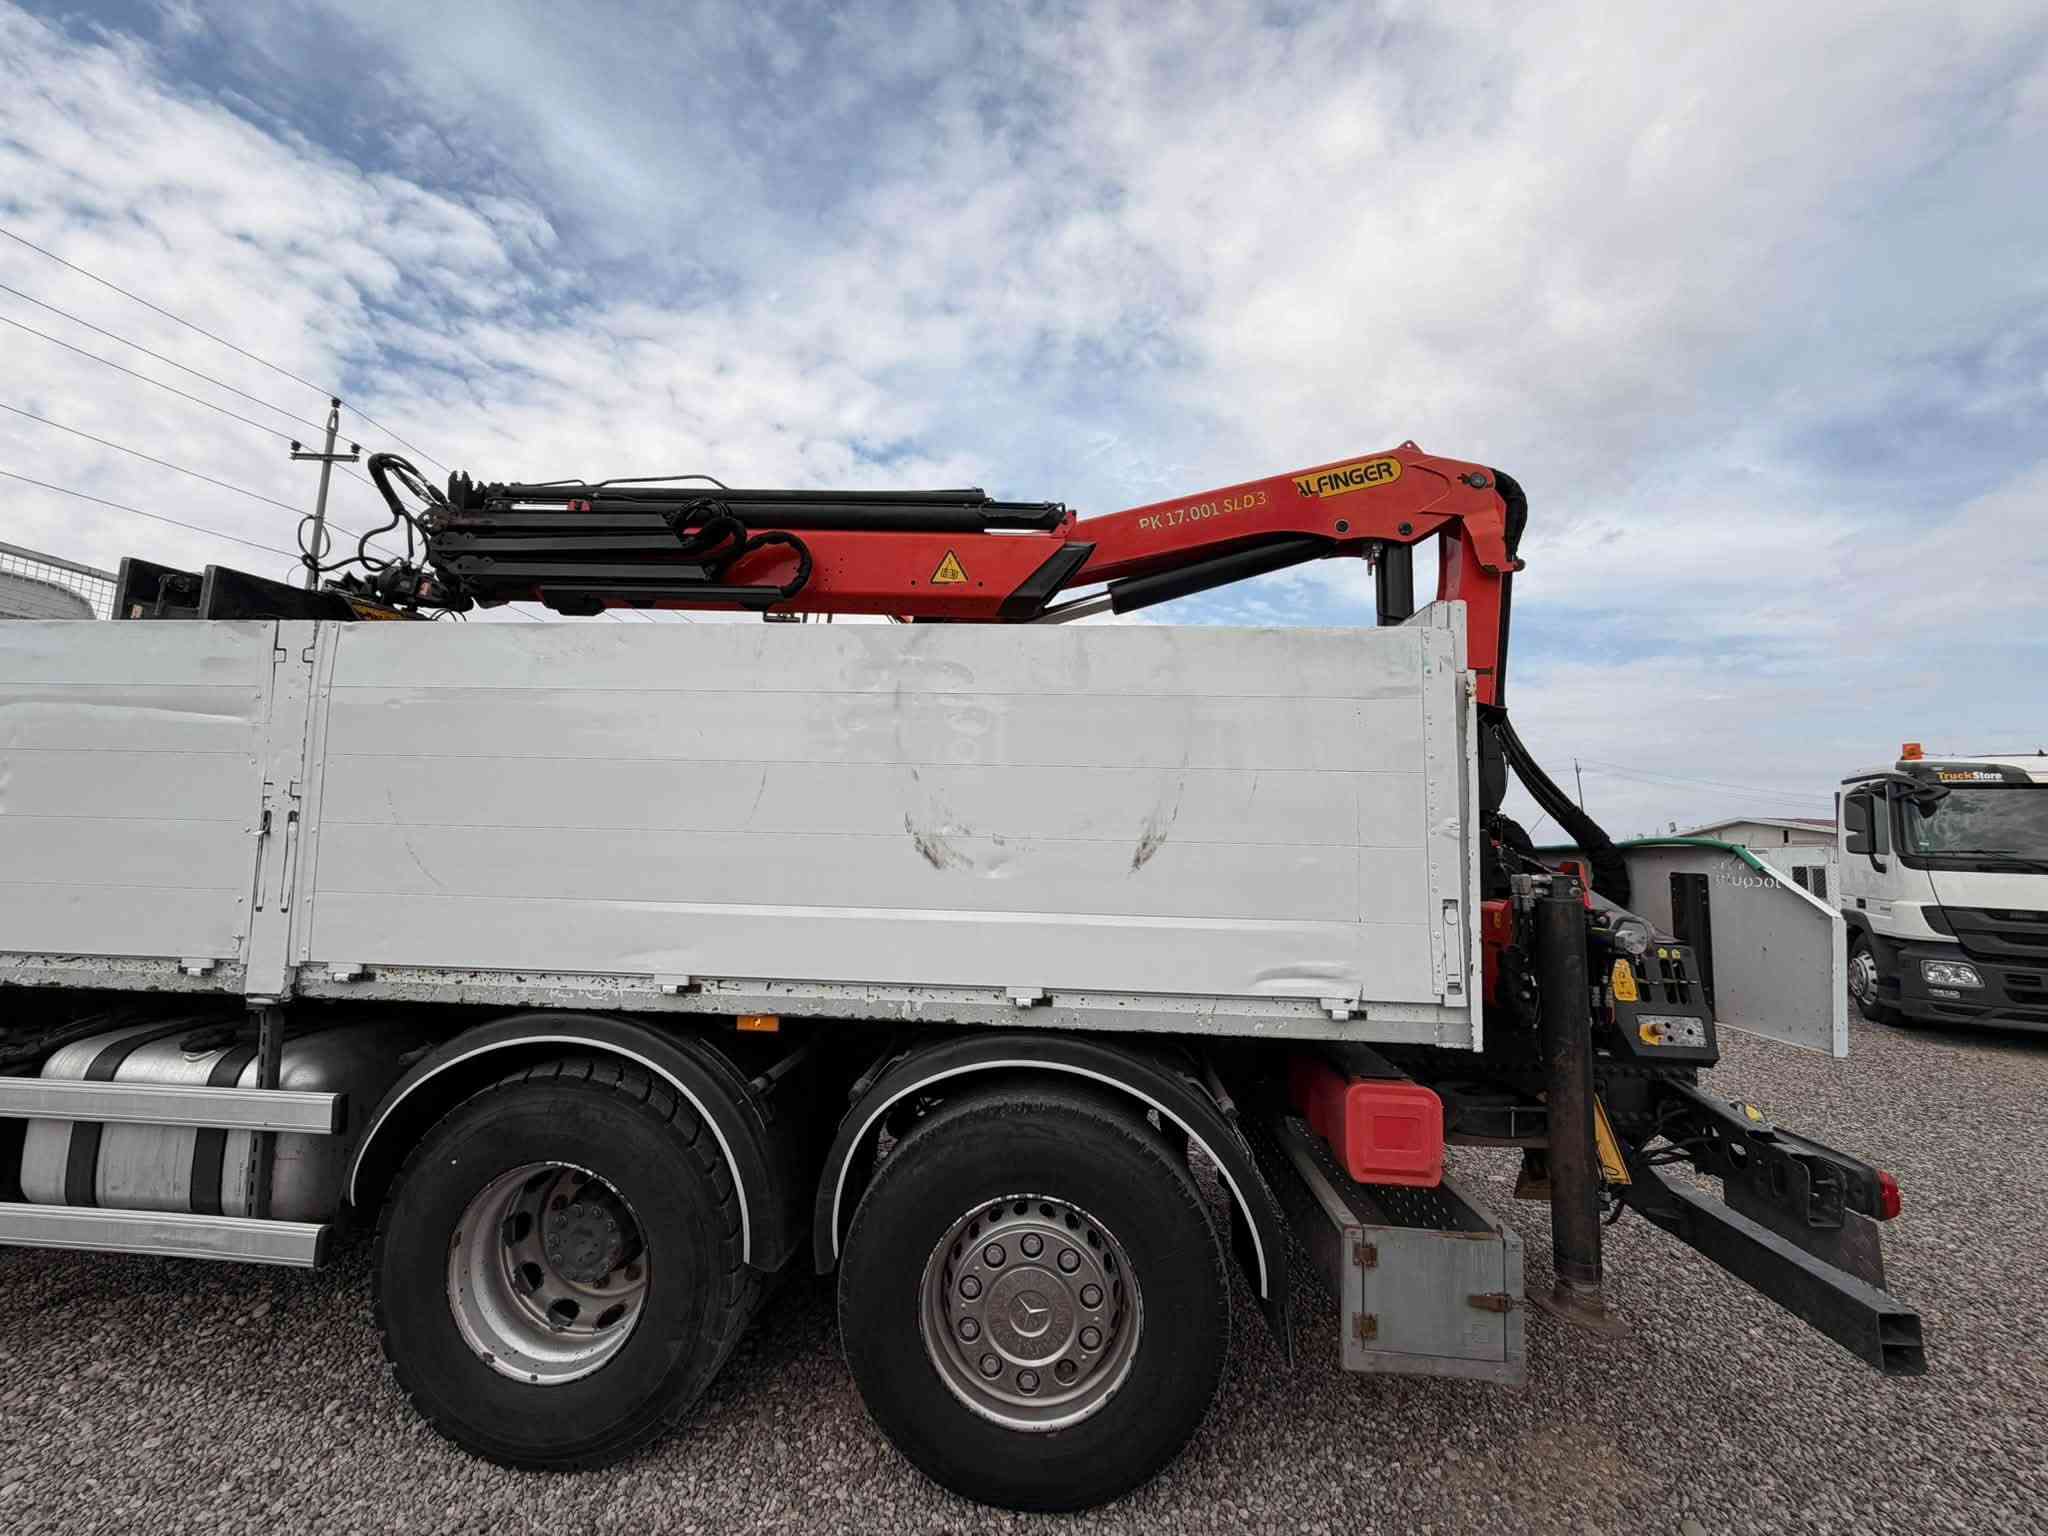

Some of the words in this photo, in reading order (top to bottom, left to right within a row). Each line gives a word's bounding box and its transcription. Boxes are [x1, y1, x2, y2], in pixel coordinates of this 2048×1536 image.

[1139, 514, 1162, 529] PK
[1166, 502, 1220, 526] 17.001
[1223, 491, 1267, 513] SLD3
[1936, 770, 2003, 780] TruckStore
